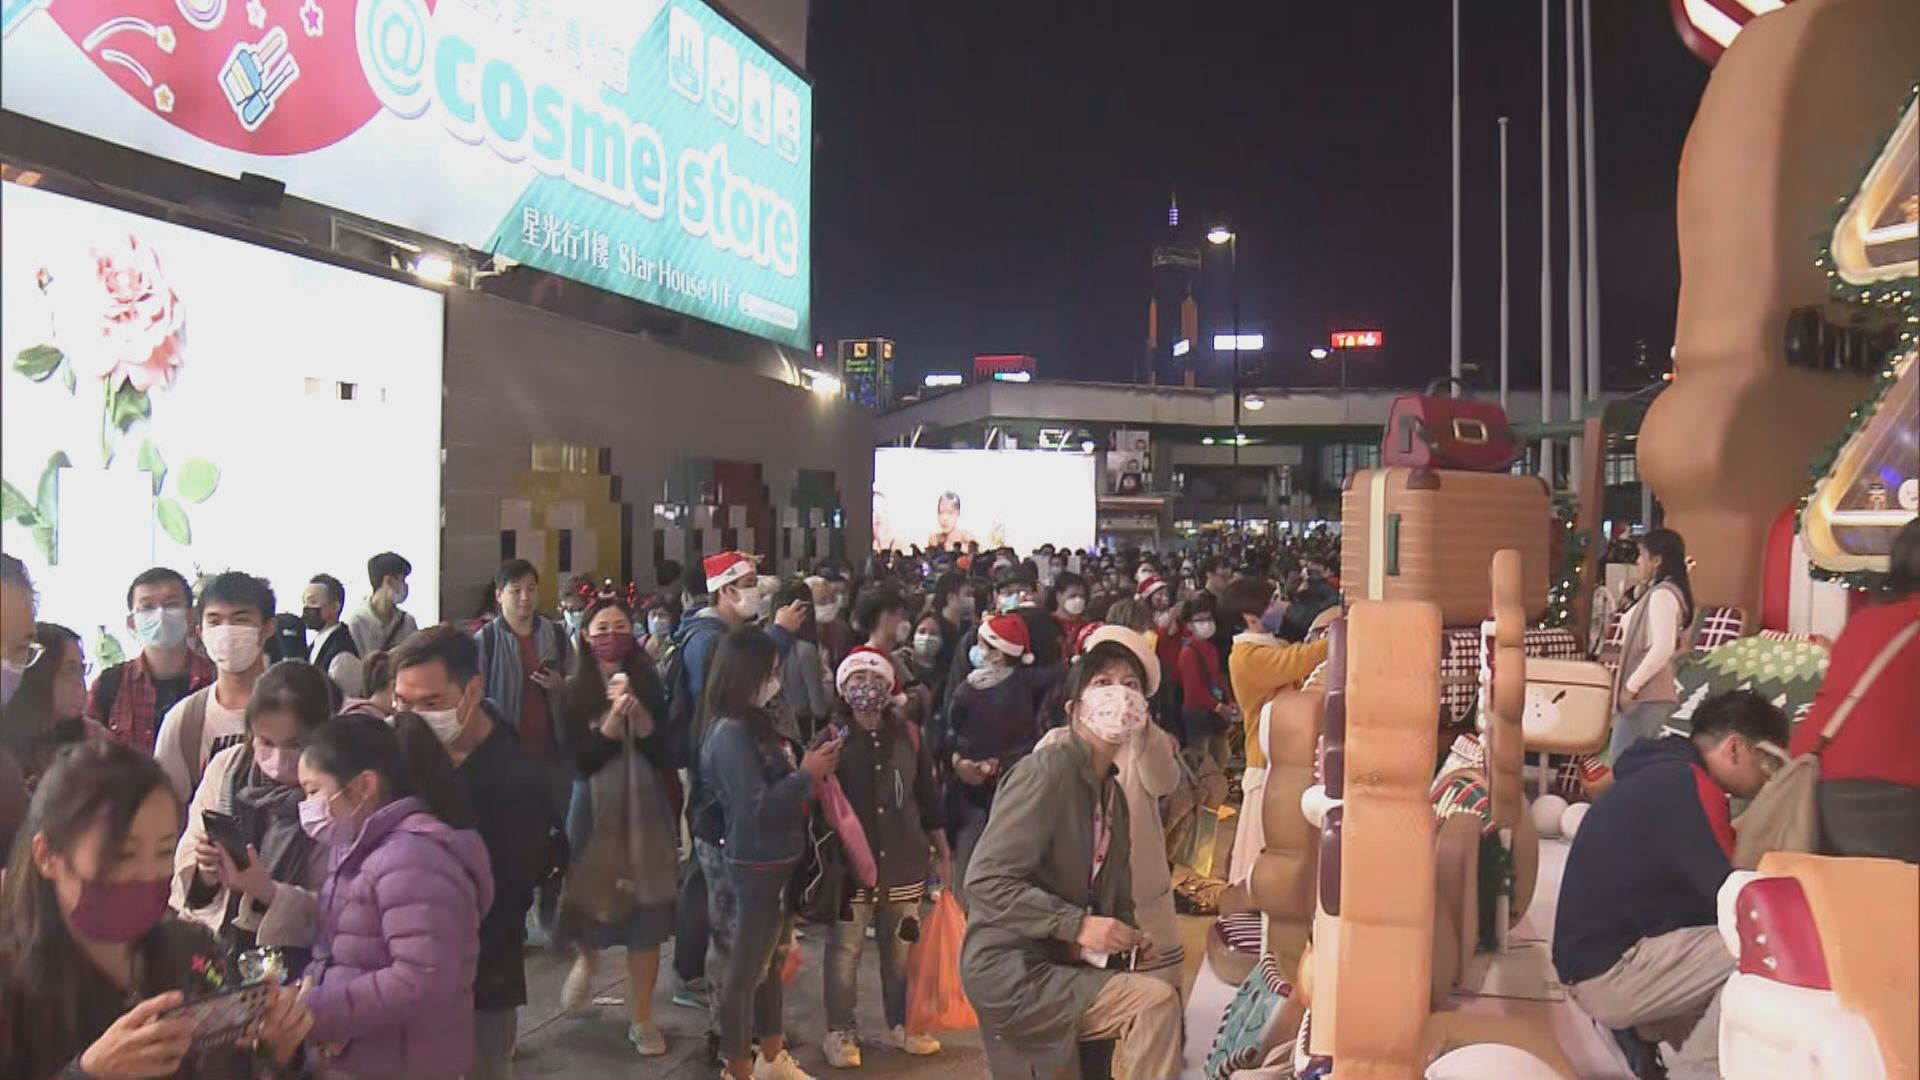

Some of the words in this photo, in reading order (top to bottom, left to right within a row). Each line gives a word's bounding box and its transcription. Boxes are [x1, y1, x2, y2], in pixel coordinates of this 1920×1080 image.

[363, 0, 663, 212] @cosme
[681, 146, 796, 264] store
[618, 242, 656, 283] Star
[658, 256, 707, 301] House
